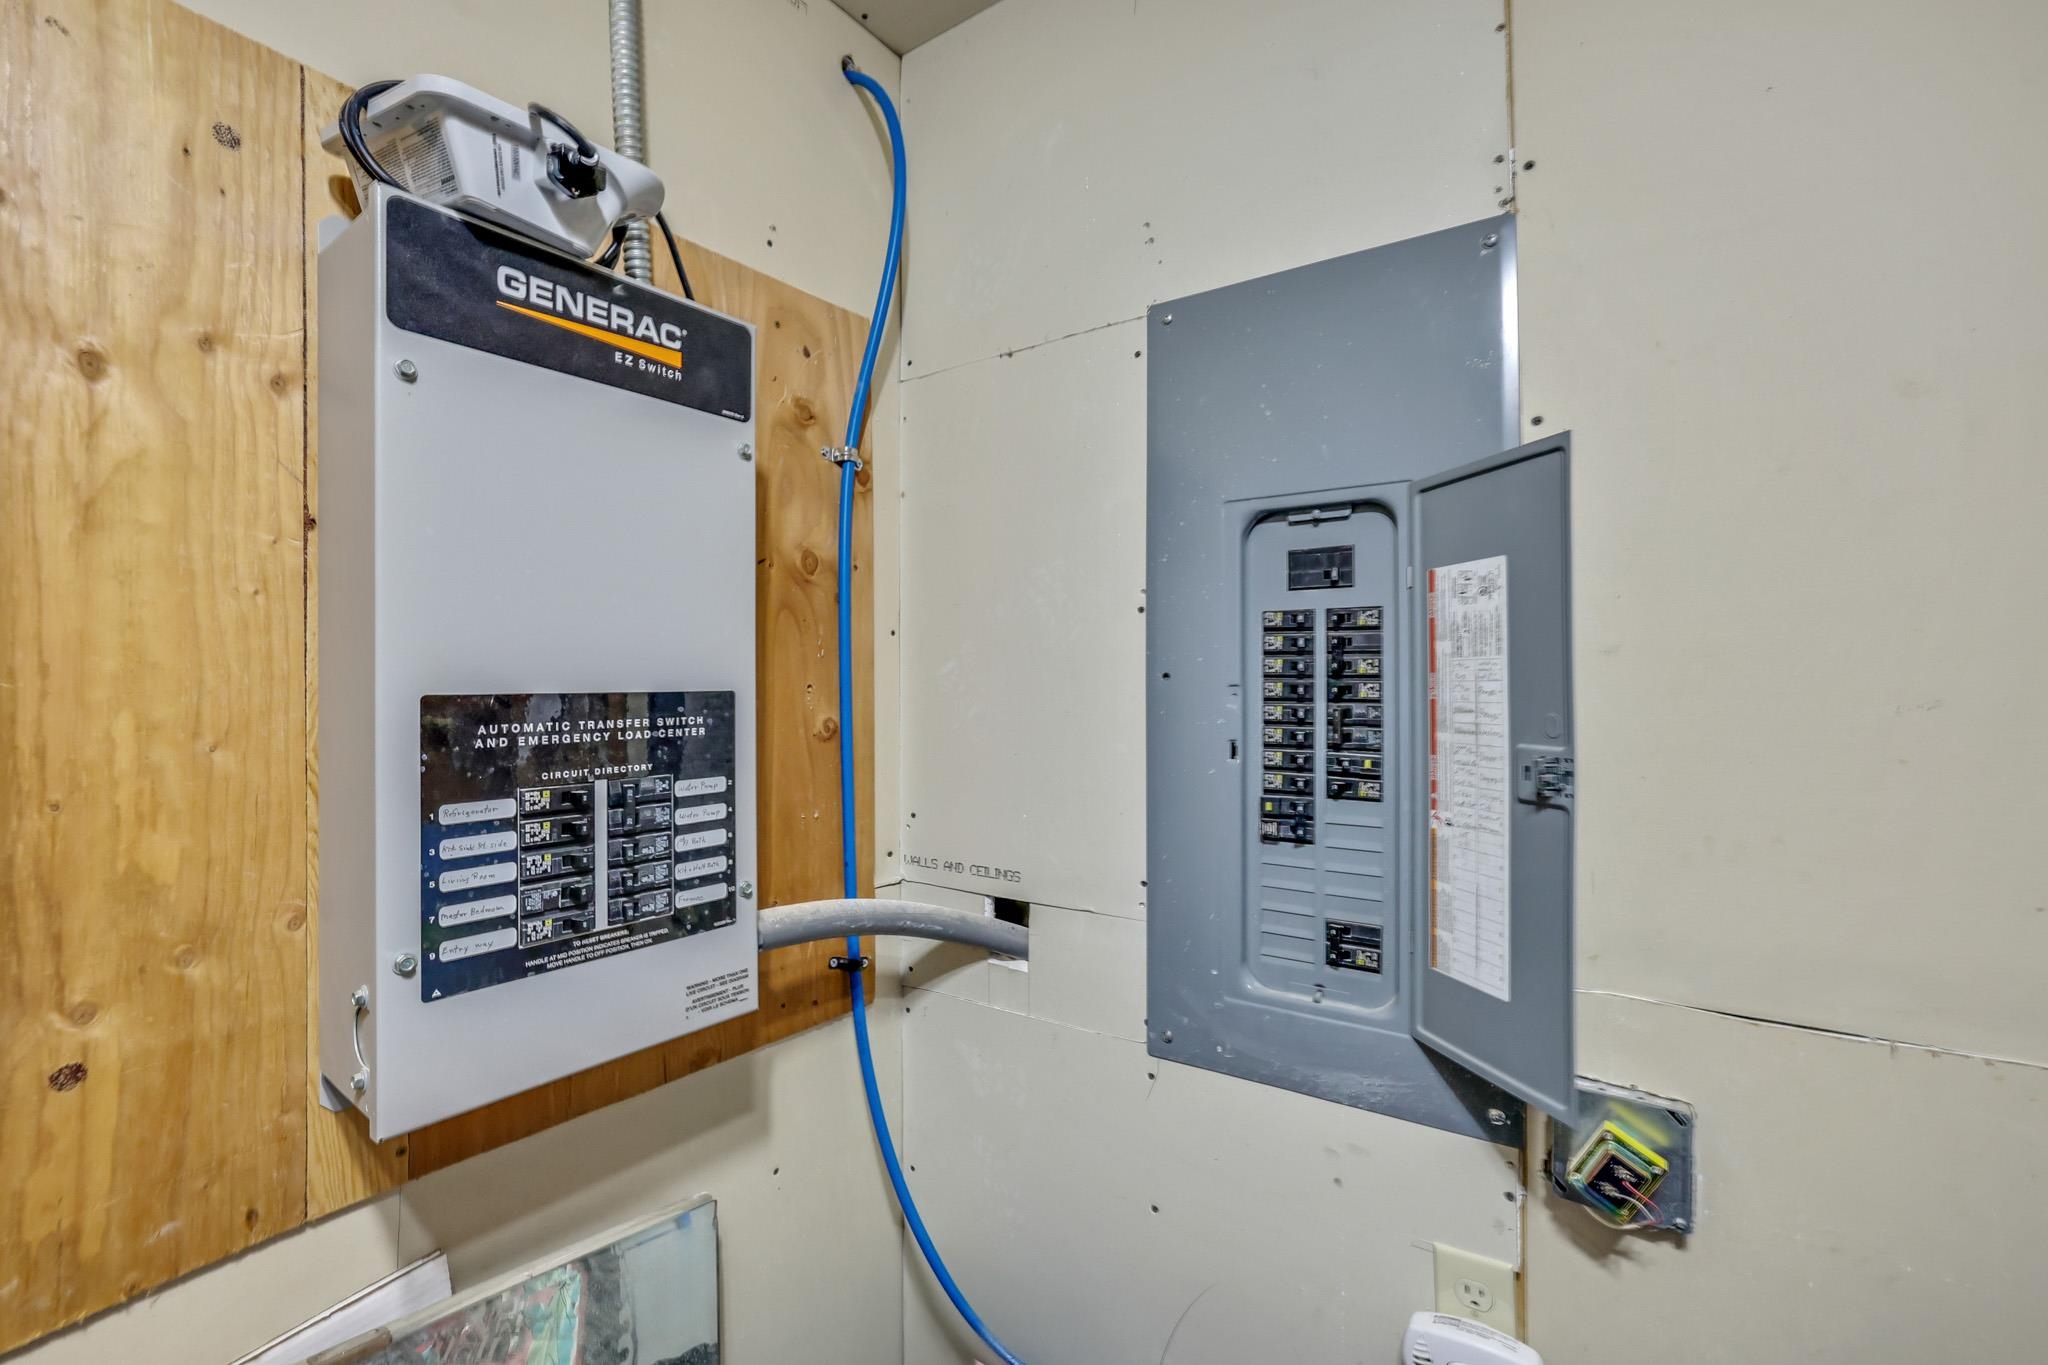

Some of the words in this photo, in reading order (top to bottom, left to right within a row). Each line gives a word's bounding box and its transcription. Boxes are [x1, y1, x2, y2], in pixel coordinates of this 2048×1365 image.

[497, 265, 683, 350] GENERAC
[615, 351, 634, 368] EZ
[638, 358, 682, 382] Switch
[477, 721, 571, 736] AUTOMATIC
[578, 718, 650, 731] TRANSFER
[656, 716, 704, 727] SWITCH
[474, 738, 508, 749] AND
[518, 731, 611, 747] EMERGENCY
[617, 730, 651, 741] LOAD
[658, 727, 706, 738] CENTER
[541, 769, 589, 780] CIRCUIT
[594, 763, 653, 776] DIRECTORY
[429, 848, 435, 856] 3
[903, 854, 938, 870] WALLS
[943, 860, 965, 874] AND
[969, 864, 1021, 883] CEILINGS
[728, 885, 735, 893] 10
[428, 916, 435, 924] 7
[429, 952, 436, 960] 9
[442, 944, 469, 955] Entry
[525, 957, 549, 968] HANDLE
[568, 946, 594, 958] POSITION
[546, 960, 564, 970] MOVE
[564, 955, 586, 965] HANDLE
